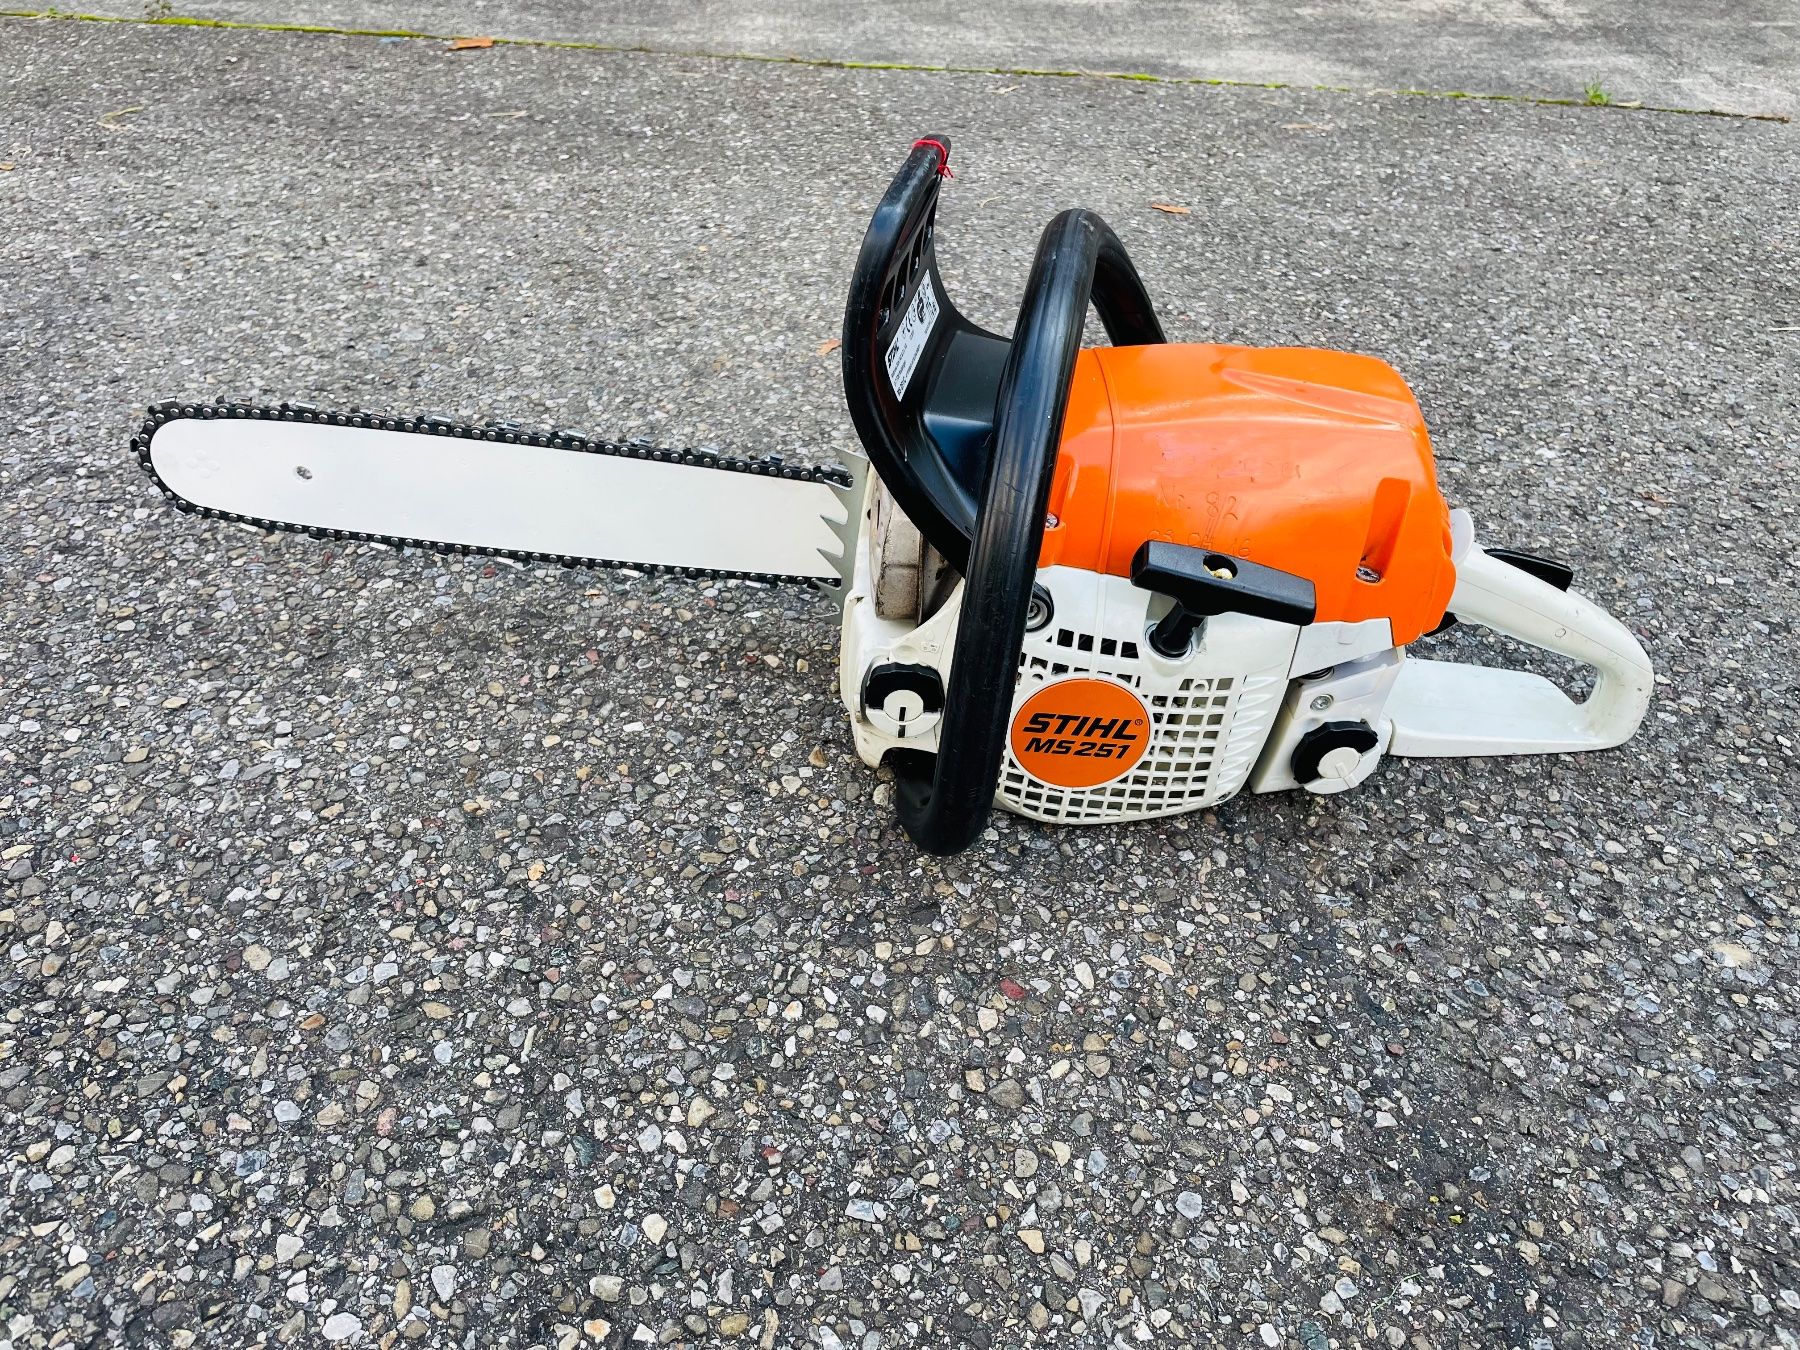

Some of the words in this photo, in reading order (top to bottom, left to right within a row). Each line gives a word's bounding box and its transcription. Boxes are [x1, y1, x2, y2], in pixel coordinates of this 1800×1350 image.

[1022, 712, 1138, 741] STIHL
[1024, 737, 1077, 755] MS
[1072, 741, 1131, 759] 251
